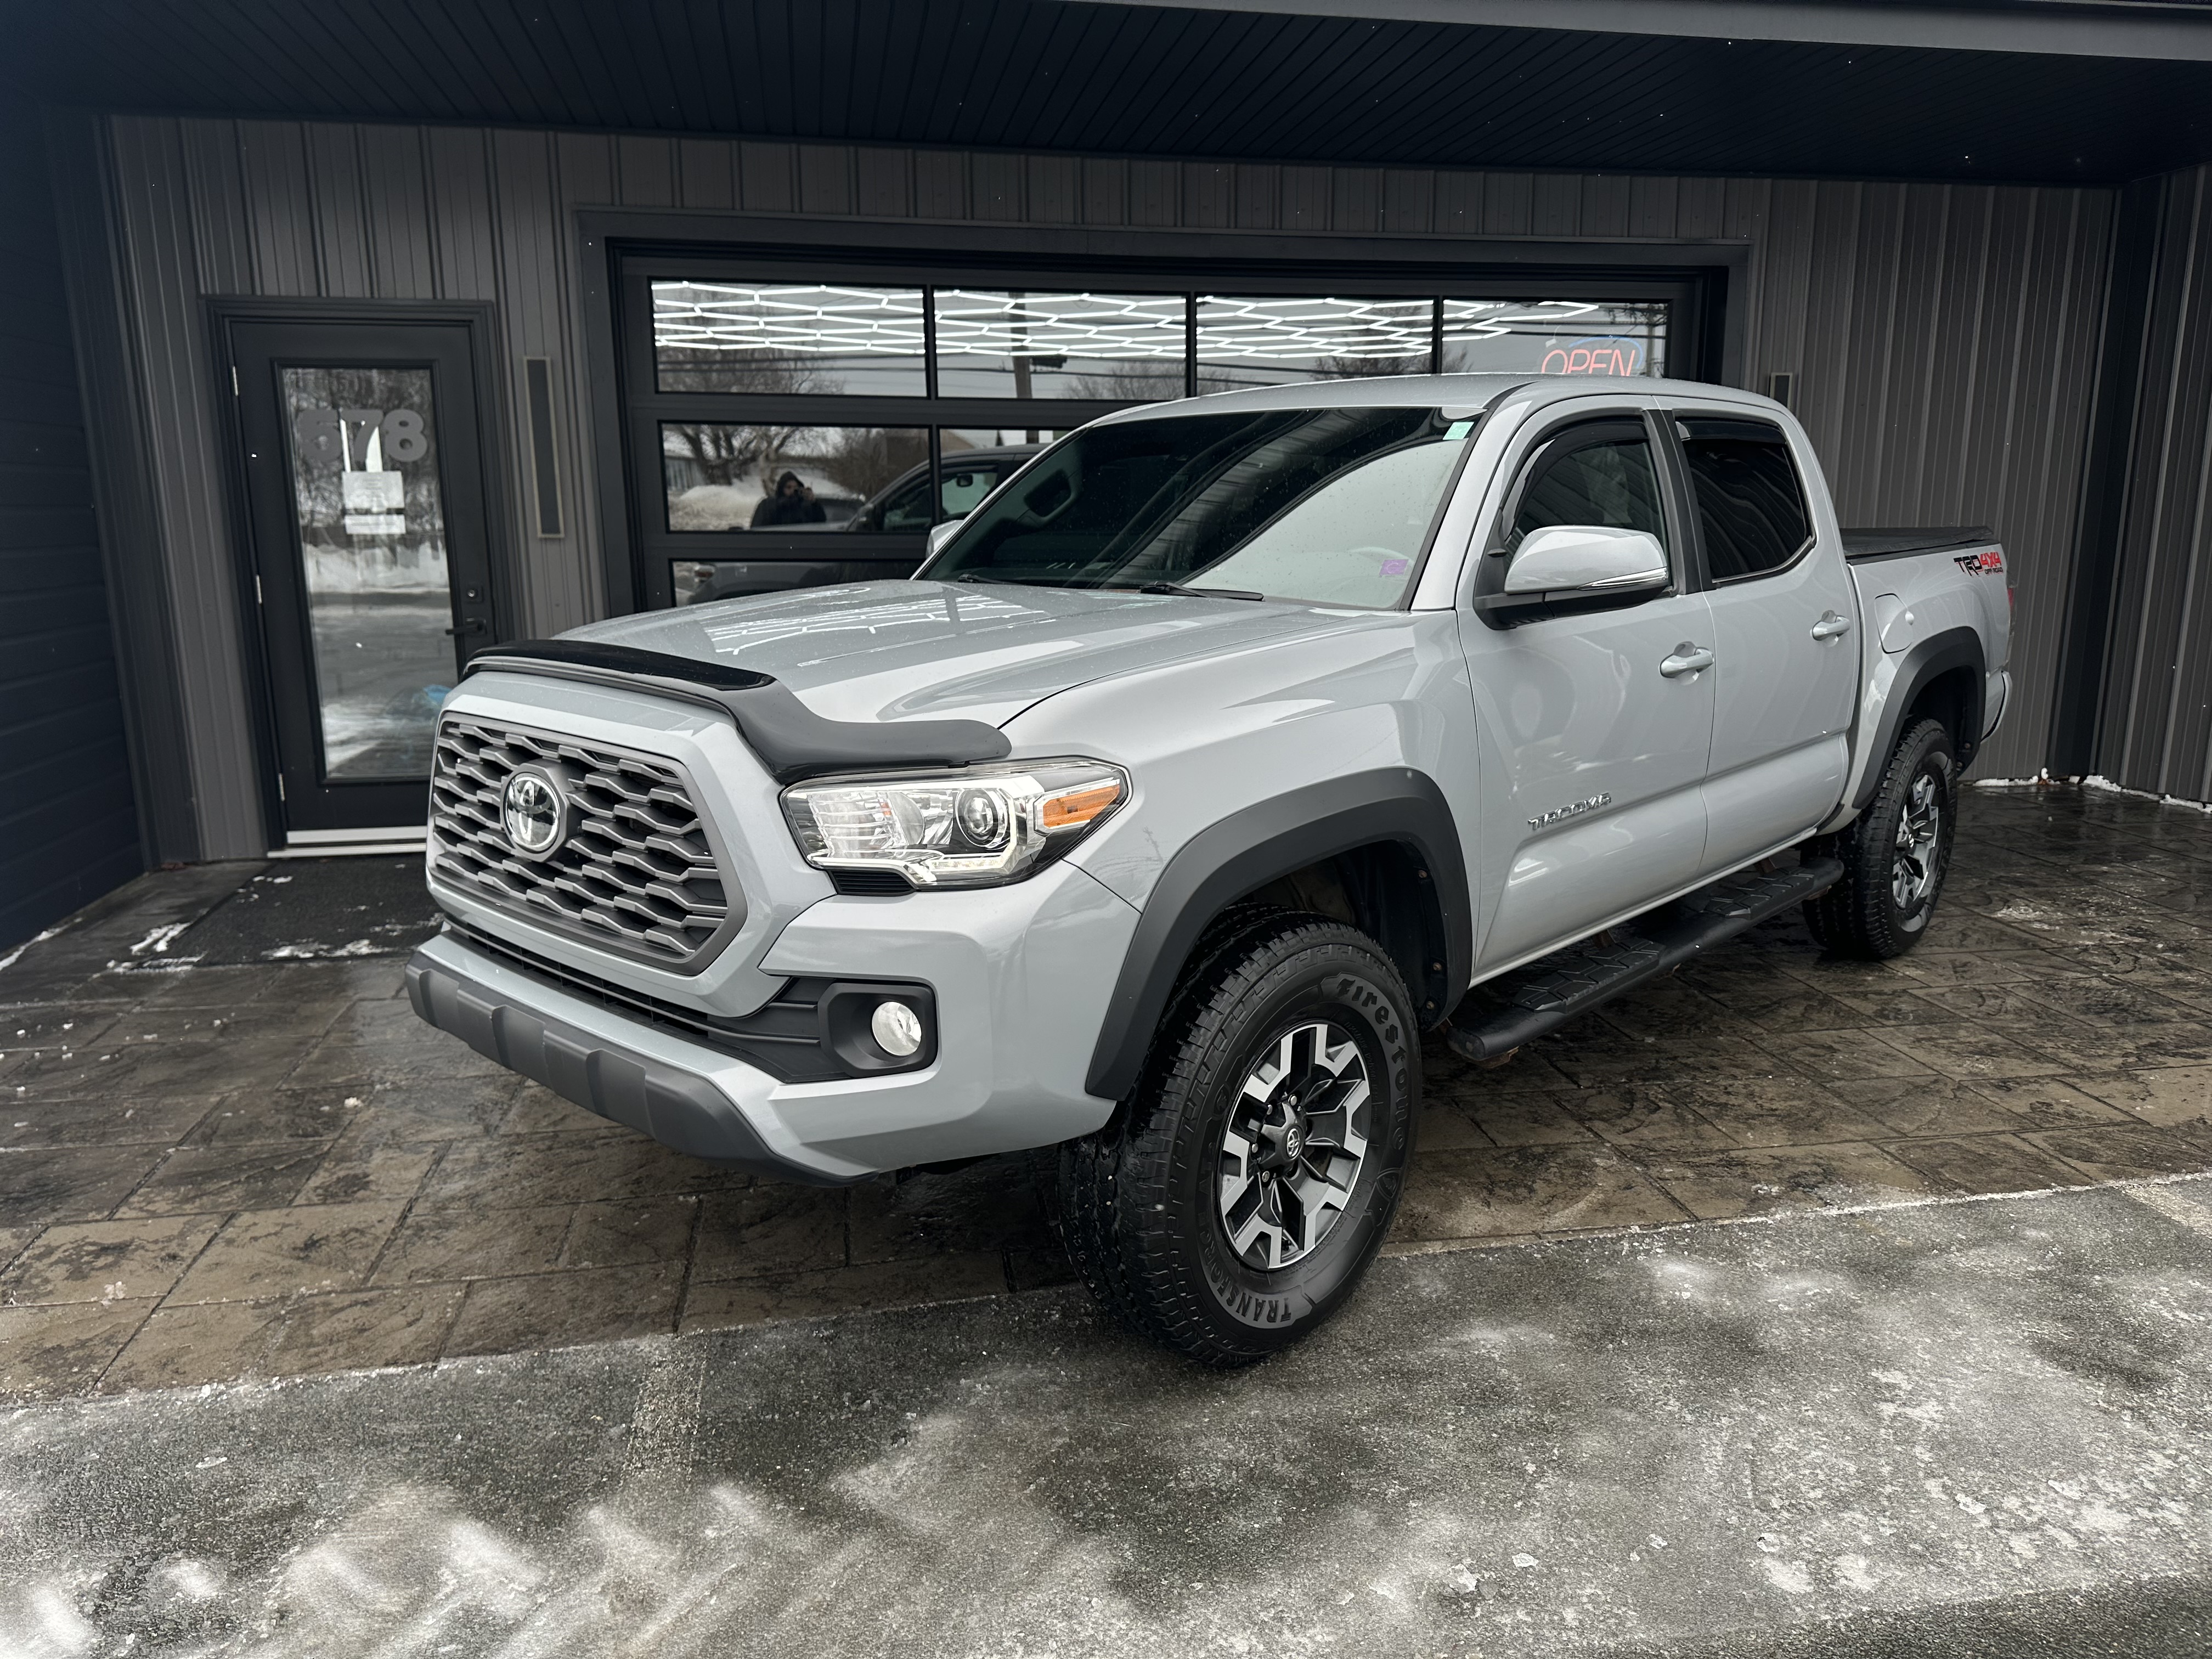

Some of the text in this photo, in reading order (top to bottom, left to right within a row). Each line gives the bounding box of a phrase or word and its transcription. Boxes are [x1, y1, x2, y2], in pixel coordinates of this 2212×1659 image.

[1541, 349, 1635, 376] OPEN
[1954, 555, 1983, 577] TRD
[1528, 792, 1611, 831] TACOMA
[1336, 978, 1409, 1150] Firestone
